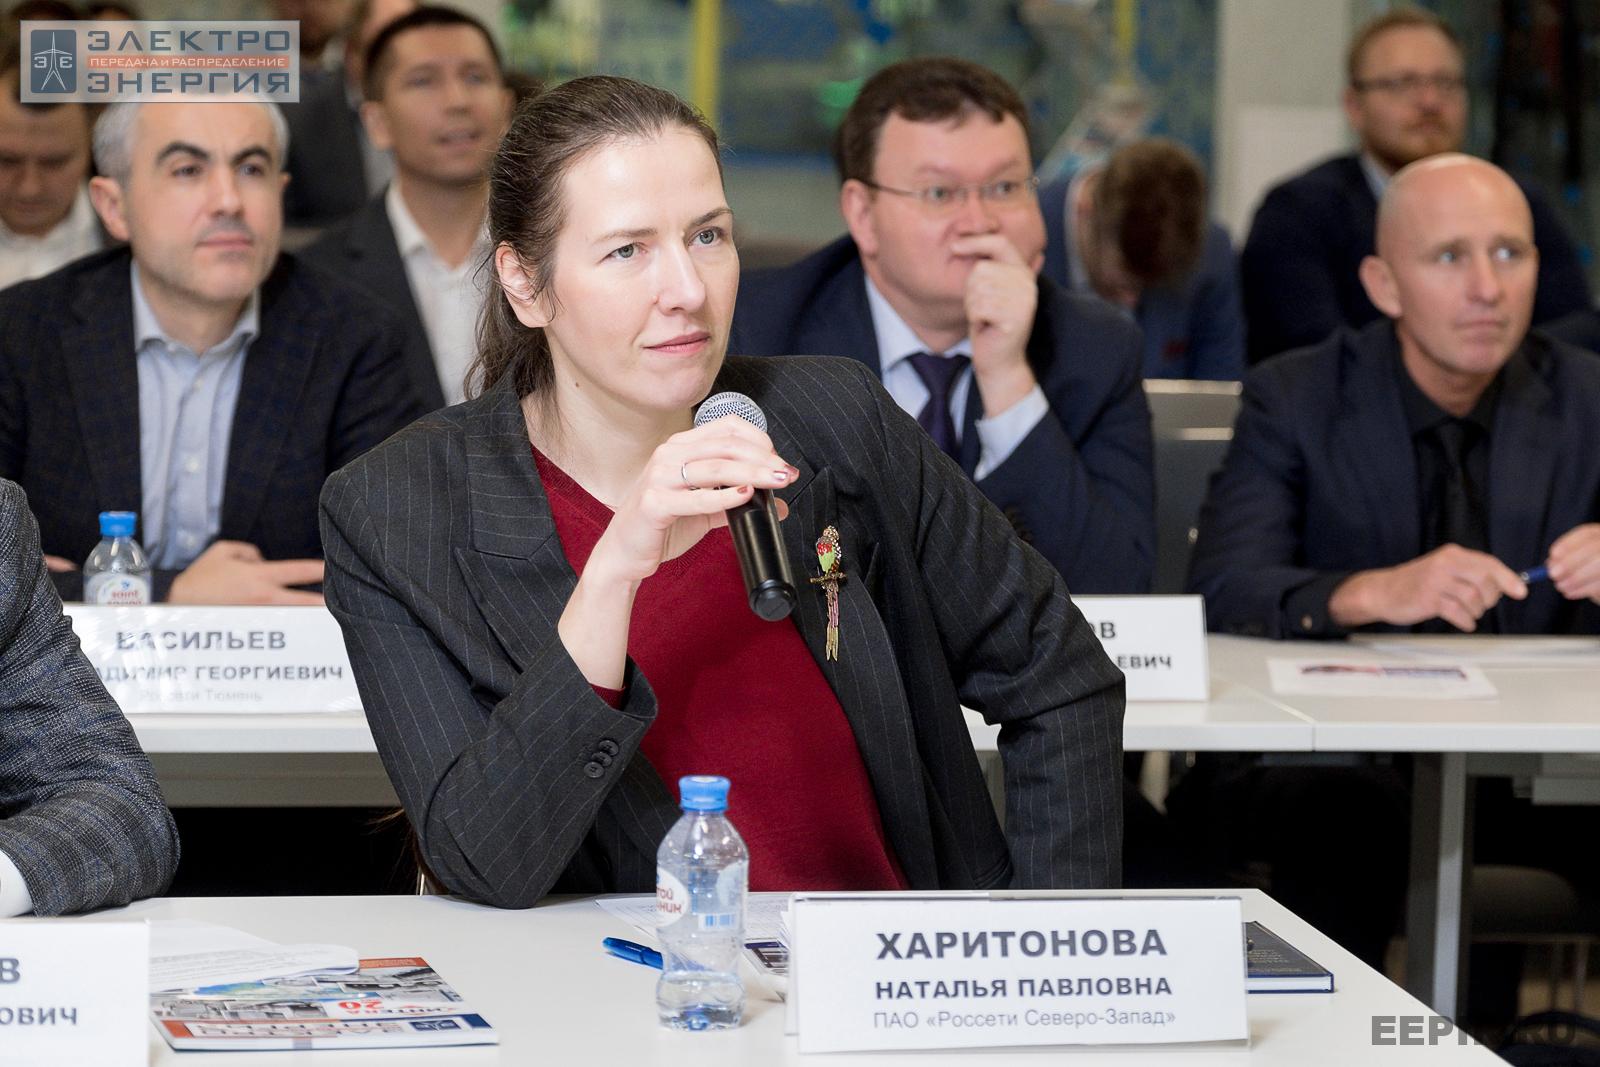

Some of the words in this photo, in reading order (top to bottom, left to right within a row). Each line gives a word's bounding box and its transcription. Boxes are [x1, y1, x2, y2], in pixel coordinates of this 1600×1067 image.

[195, 666, 343, 681] ГЕОРГИЕВИЧ
[876, 930, 1168, 960] ХАРИТОНОВА
[876, 980, 1007, 999] НАТАЛЬЯ
[1018, 978, 1172, 997] ПАВЛОВНА
[0, 1006, 77, 1025] ОВИЧ
[874, 1011, 920, 1029] ПАО
[926, 1010, 1018, 1028] «Россети
[1025, 1008, 1176, 1029] Северо-Запад»
